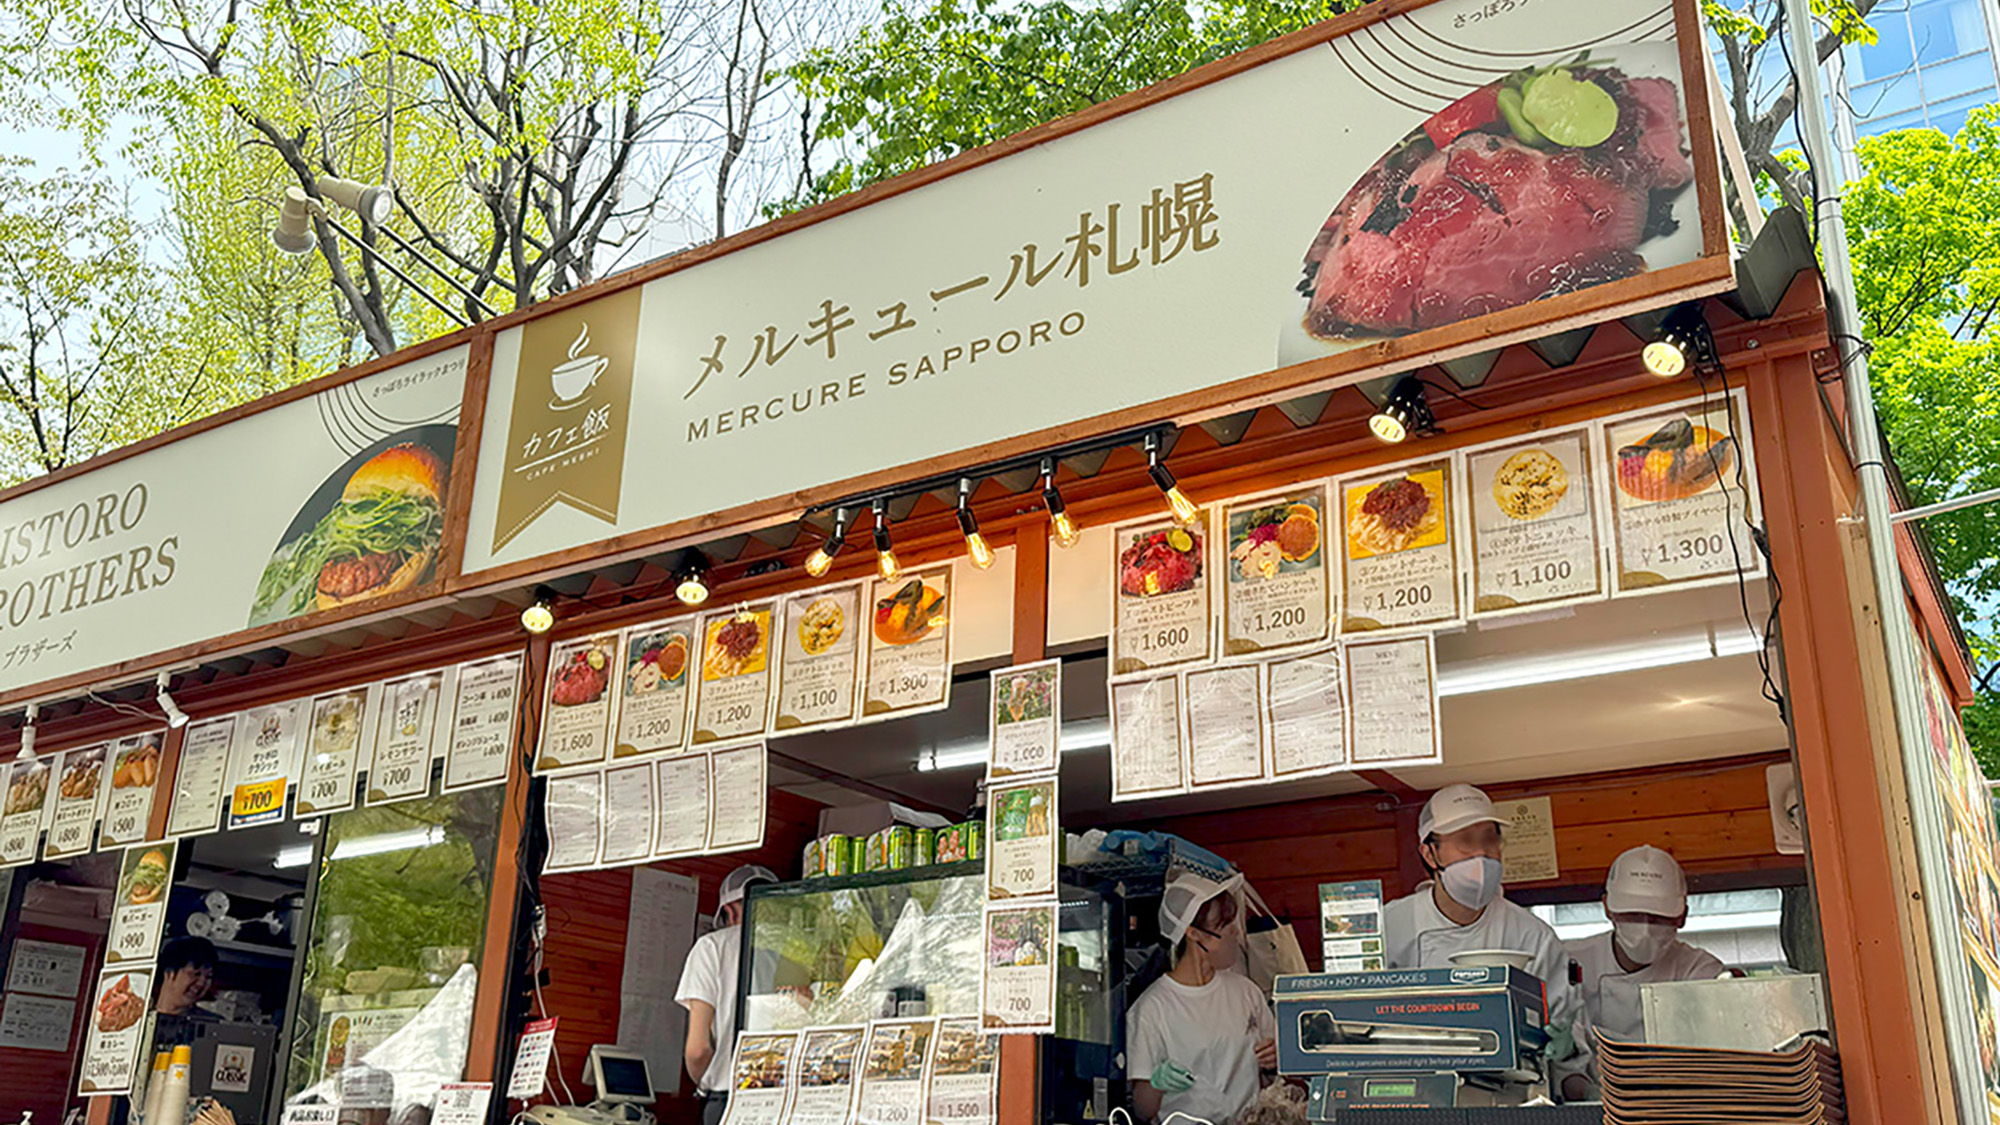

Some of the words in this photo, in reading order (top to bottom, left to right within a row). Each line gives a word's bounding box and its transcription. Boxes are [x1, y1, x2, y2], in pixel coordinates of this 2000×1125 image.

[683, 172, 1221, 400] メルキュール札幌
[686, 373, 867, 442] MERCURE
[888, 311, 1086, 386] SAPPORO
[523, 403, 611, 458] カフェ飯
[526, 463, 556, 480] CAFE
[562, 448, 600, 467] MESHI
[3, 629, 77, 669] ブラザーズ
[1291, 979, 1329, 990] FRESH
[1336, 976, 1359, 987] HOT
[1367, 973, 1427, 985] PANCAKES
[1407, 1002, 1455, 1014] COUNTDOWN
